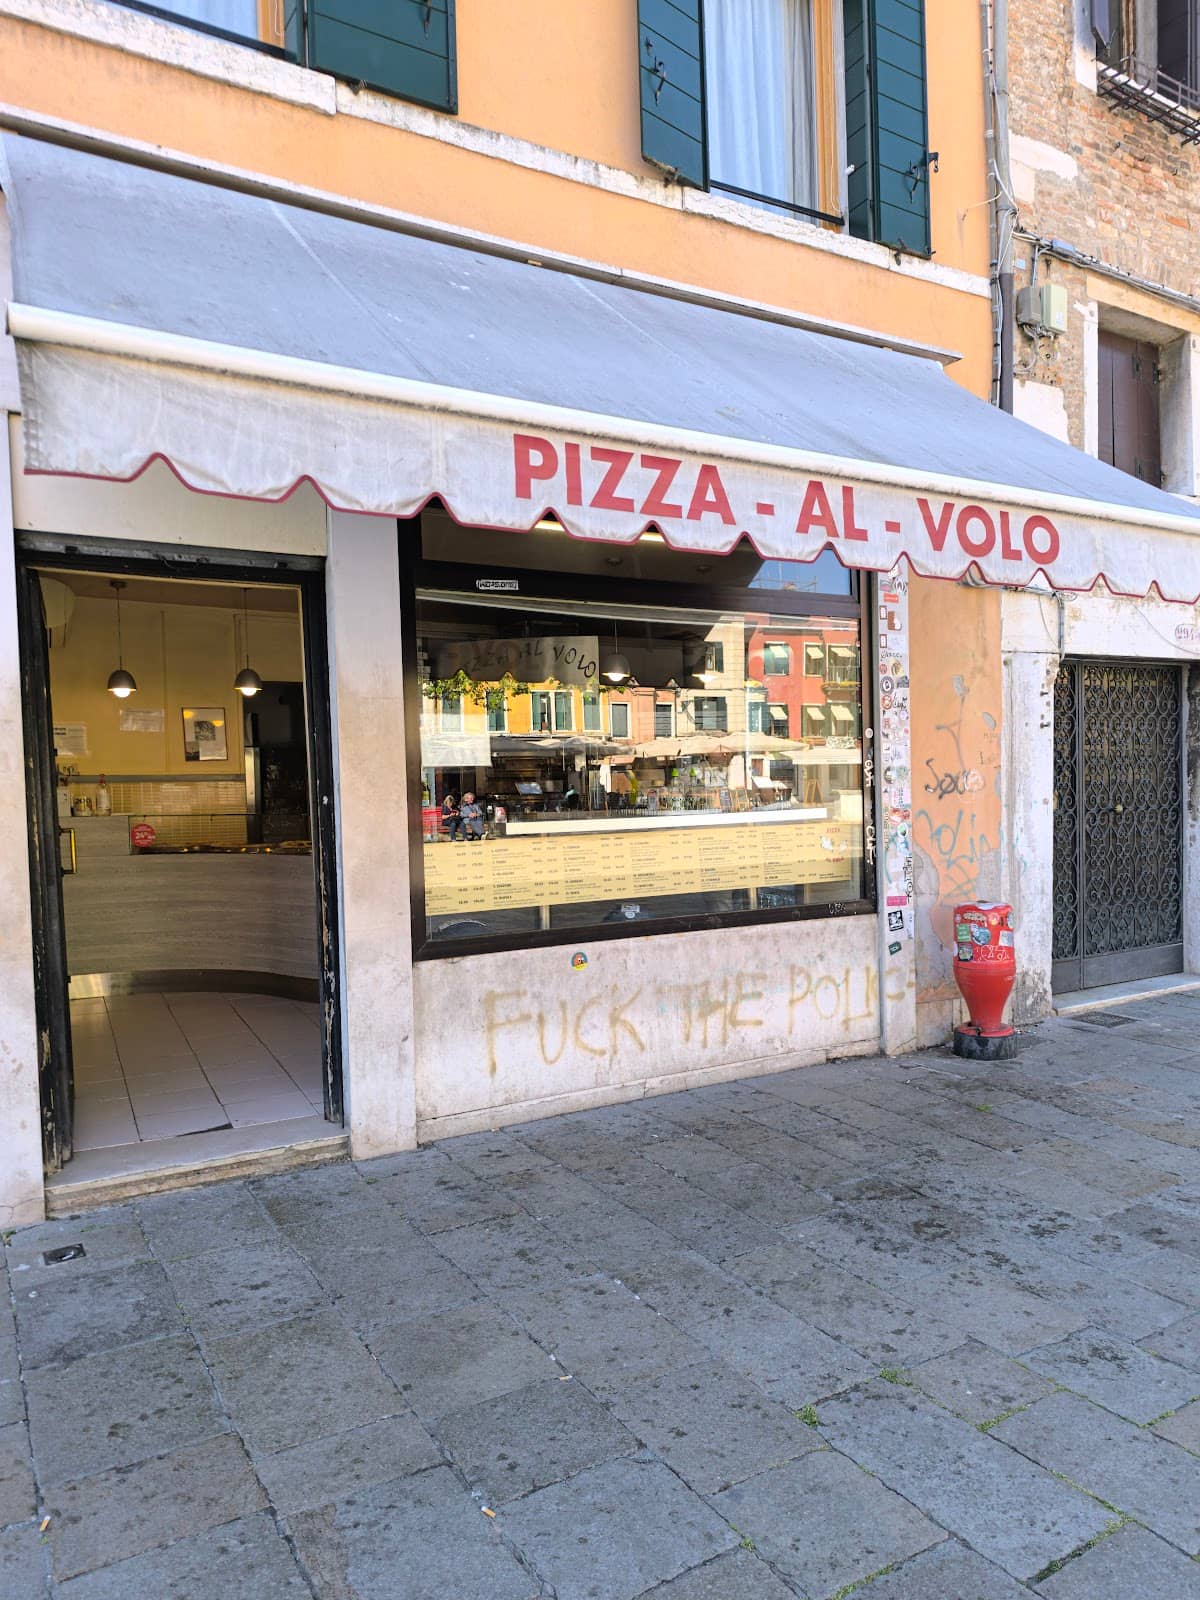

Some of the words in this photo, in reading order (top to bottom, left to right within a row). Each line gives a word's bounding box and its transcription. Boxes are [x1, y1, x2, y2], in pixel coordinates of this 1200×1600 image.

[513, 433, 736, 526] PIZZA
[795, 480, 868, 542] AL
[917, 497, 1060, 565] VOLO
[552, 644, 597, 679] VOLO
[485, 983, 646, 1079] FUCK
[656, 971, 768, 1049] THE
